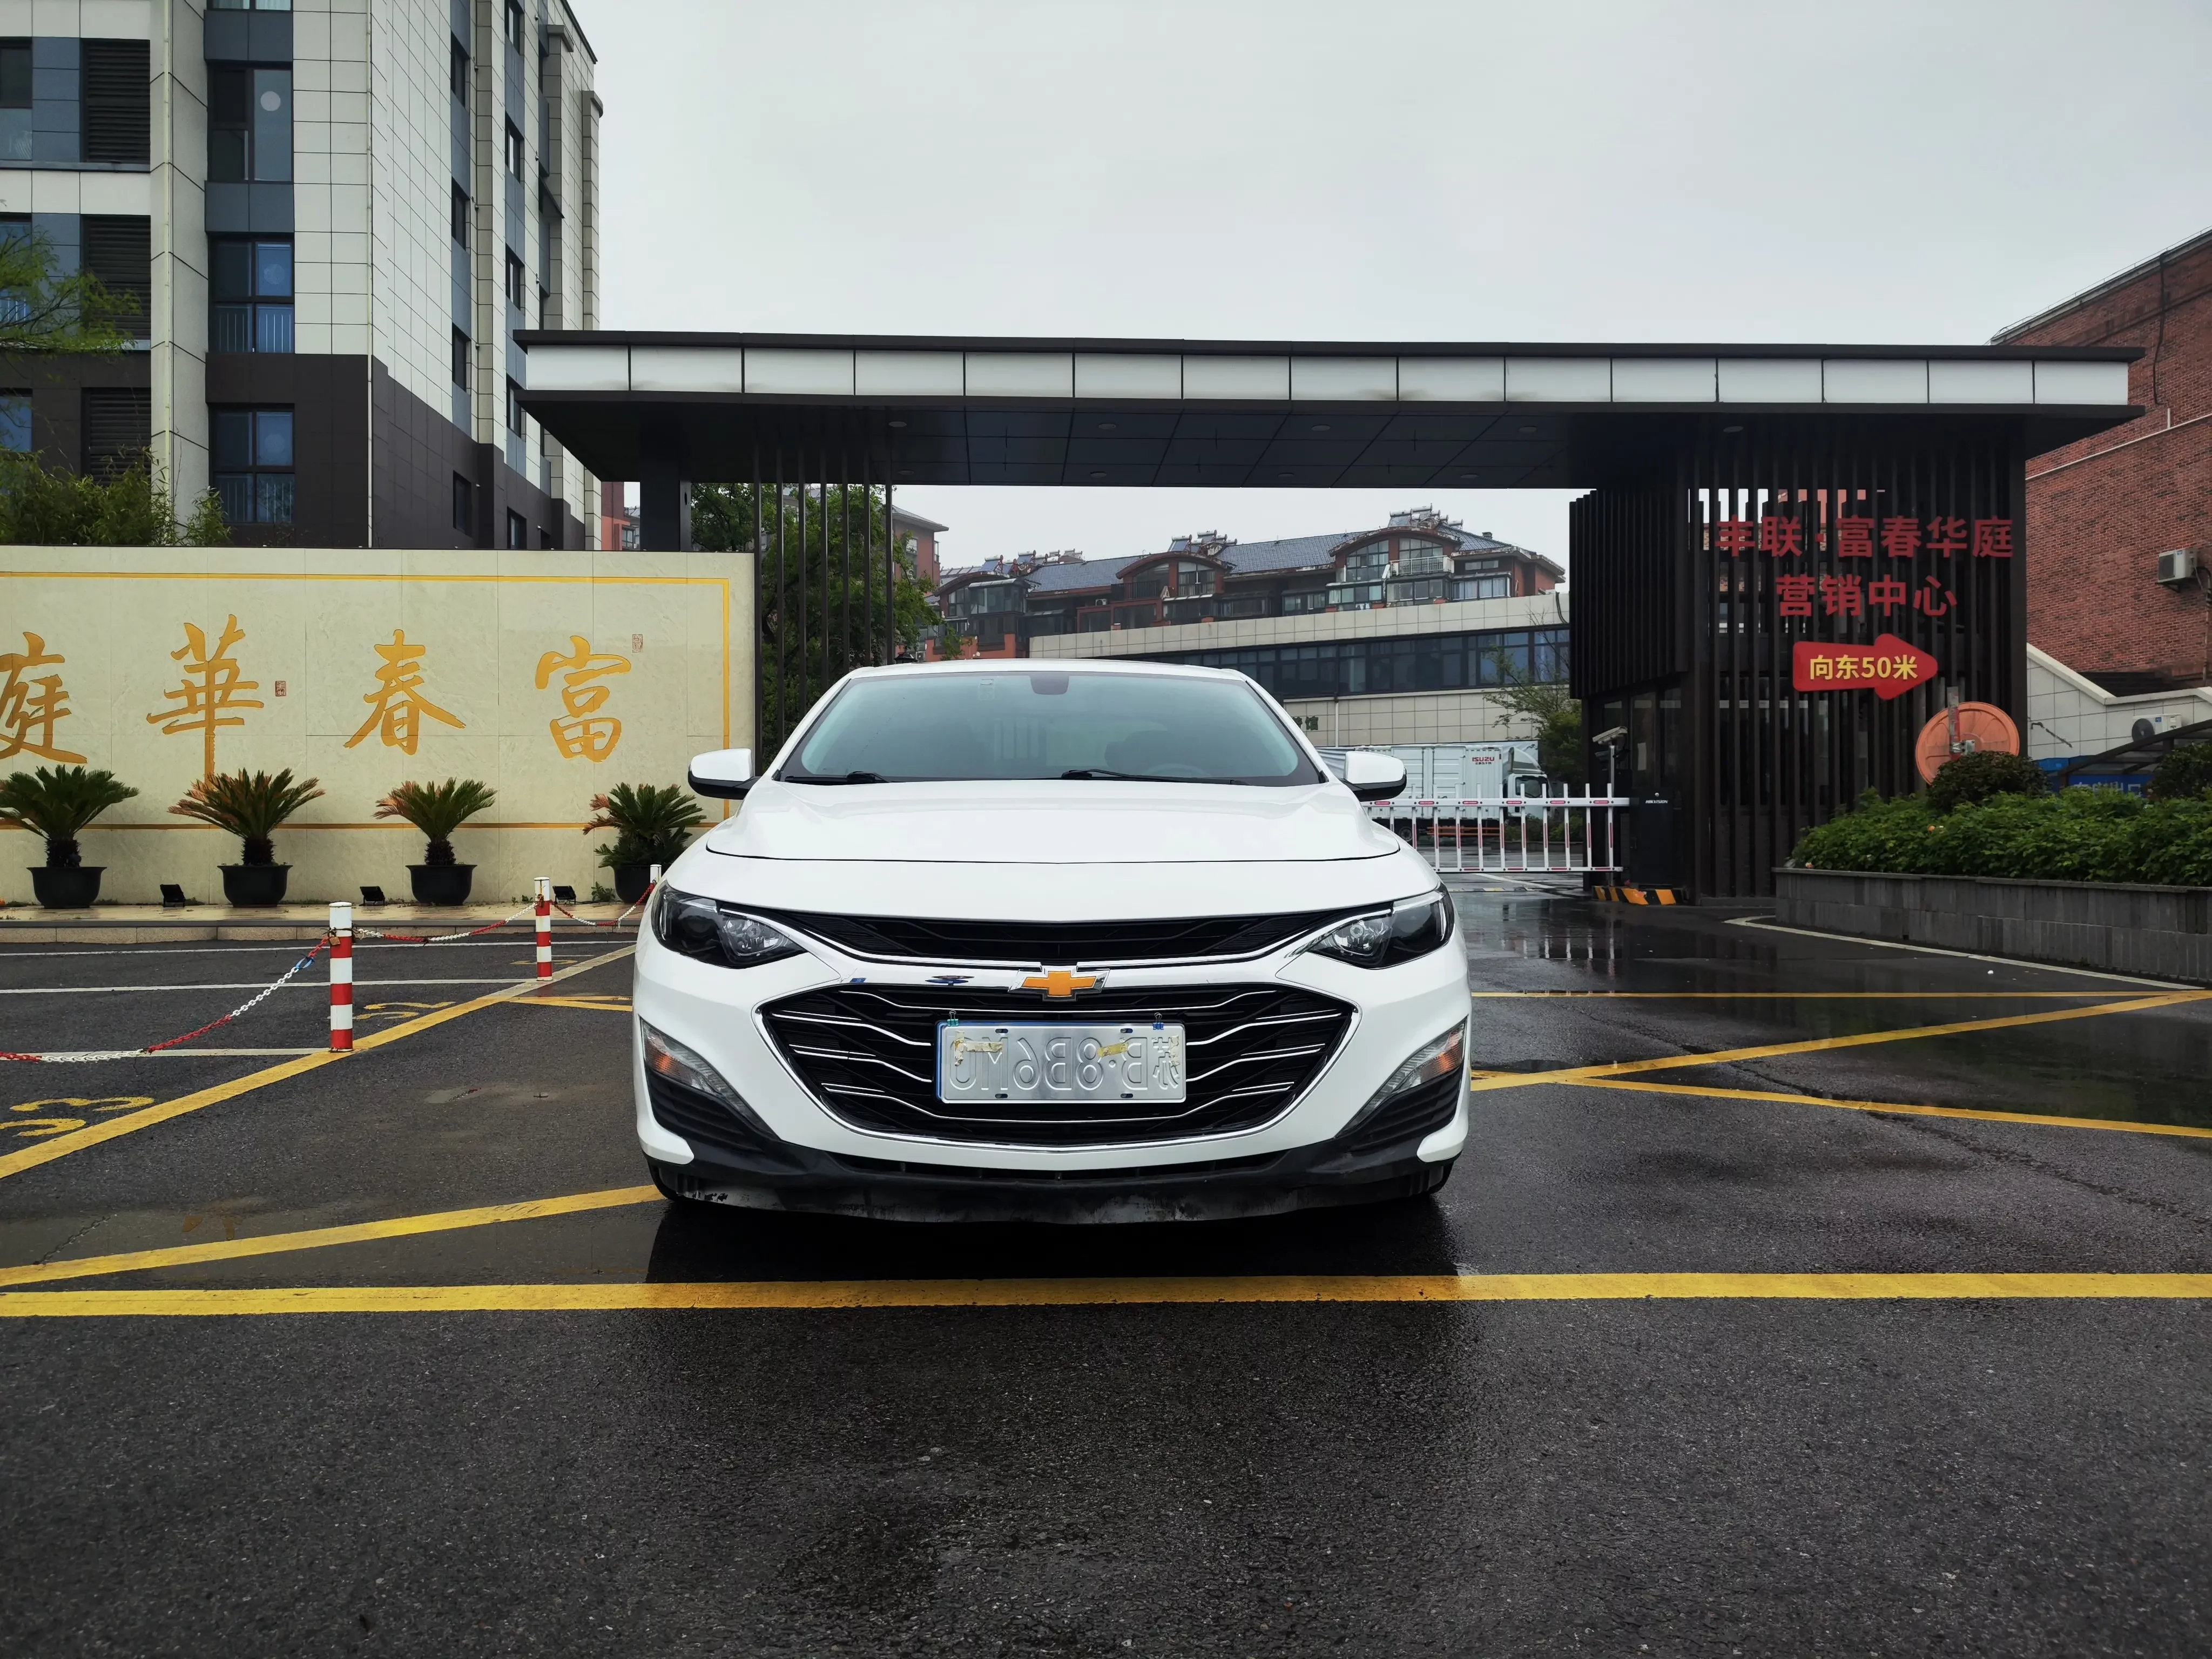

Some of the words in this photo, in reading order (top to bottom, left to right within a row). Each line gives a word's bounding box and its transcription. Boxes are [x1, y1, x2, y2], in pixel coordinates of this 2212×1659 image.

[1776, 574, 1958, 617] 营销中心
[1809, 654, 1918, 681] 向东50米
